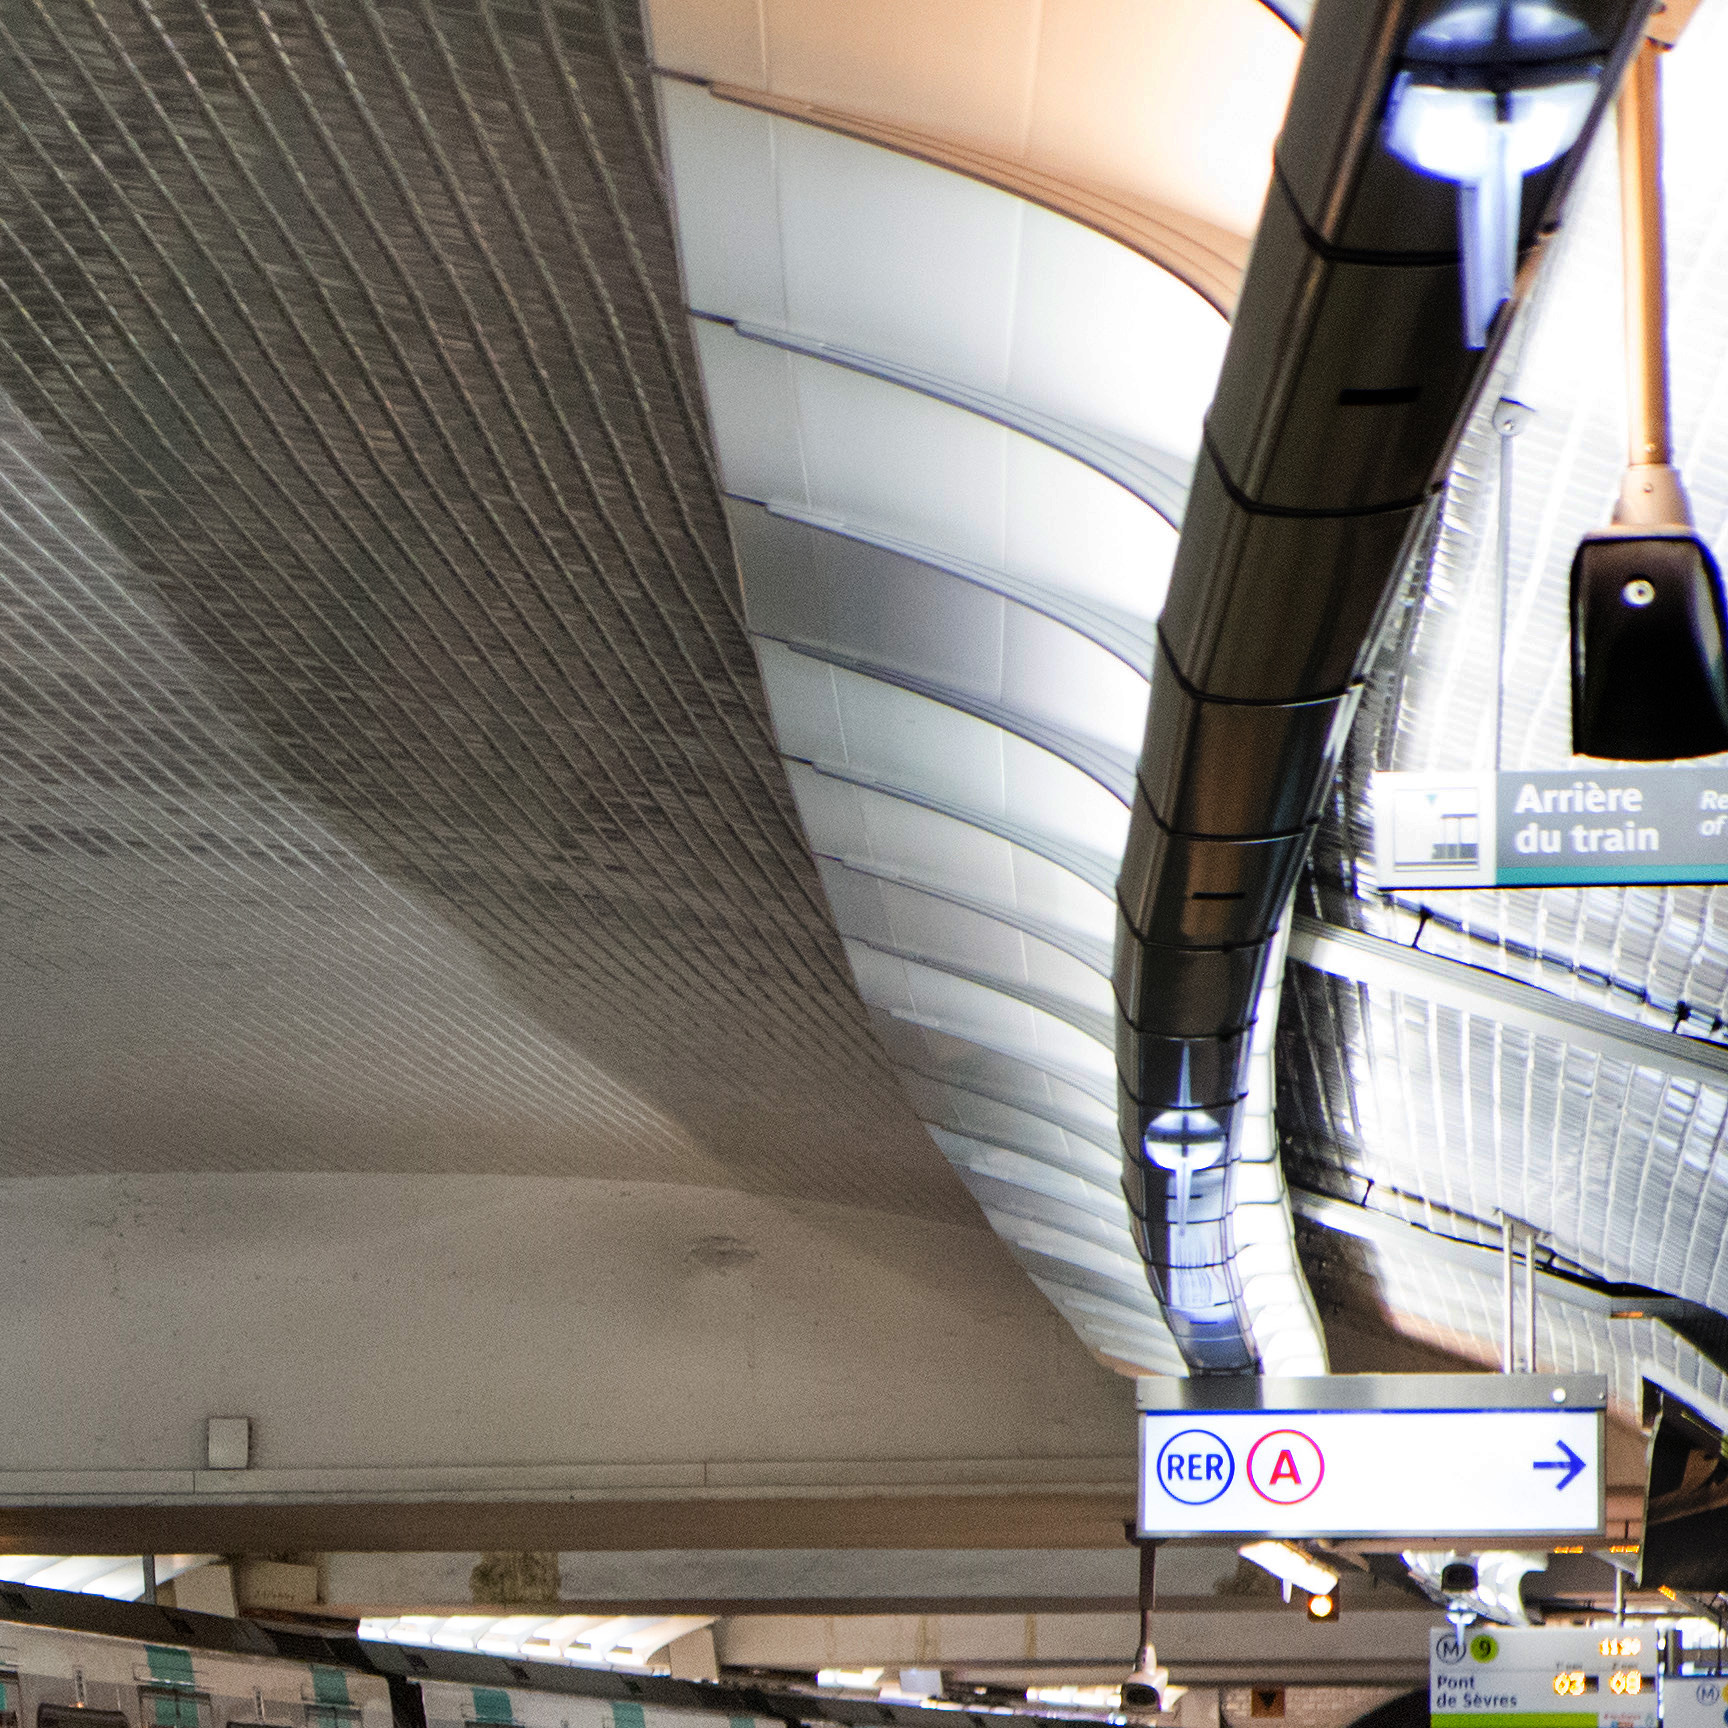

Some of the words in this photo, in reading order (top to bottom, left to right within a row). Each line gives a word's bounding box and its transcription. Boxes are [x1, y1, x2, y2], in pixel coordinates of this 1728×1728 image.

[1513, 781, 1643, 814] Arrière
[1514, 822, 1562, 854] du
[1570, 820, 1660, 853] train
[1167, 1453, 1224, 1481] RER
[1269, 1449, 1302, 1485] A
[1437, 1675, 1475, 1690] Pont
[1436, 1692, 1457, 1709] de
[1463, 1692, 1518, 1709] Sèvres
